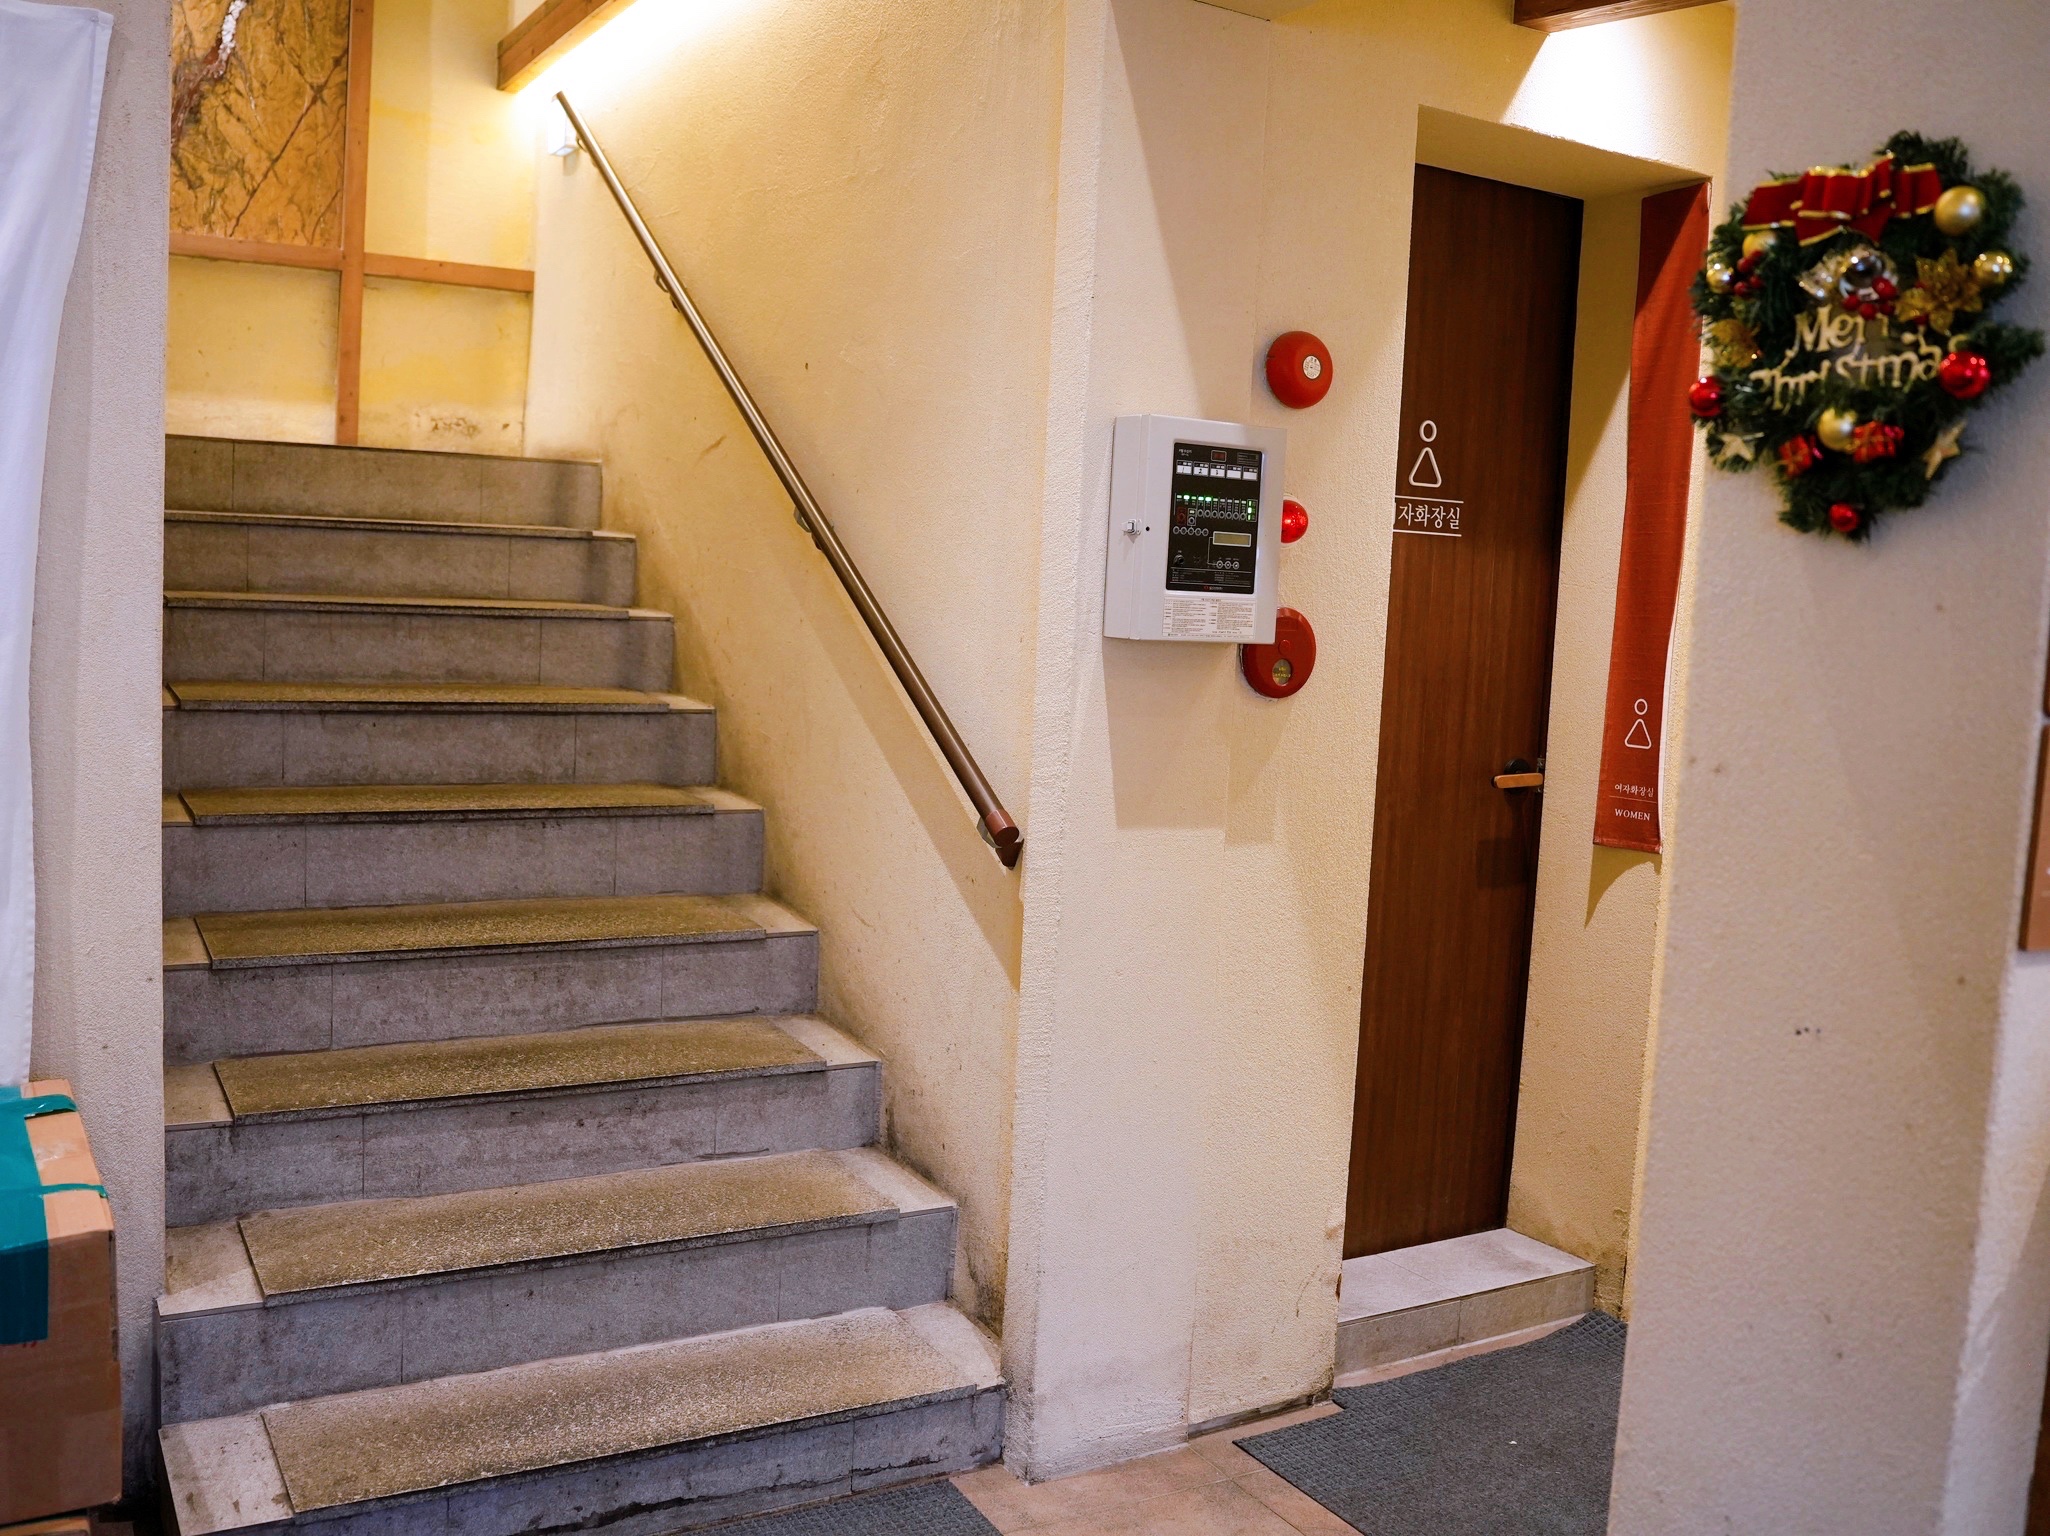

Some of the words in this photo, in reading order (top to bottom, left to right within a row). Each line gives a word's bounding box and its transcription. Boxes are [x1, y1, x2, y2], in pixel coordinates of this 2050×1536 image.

[1393, 502, 1461, 530] 자화장실
[1614, 783, 1654, 798] 여자화장실
[1614, 808, 1651, 821] WOMEN
